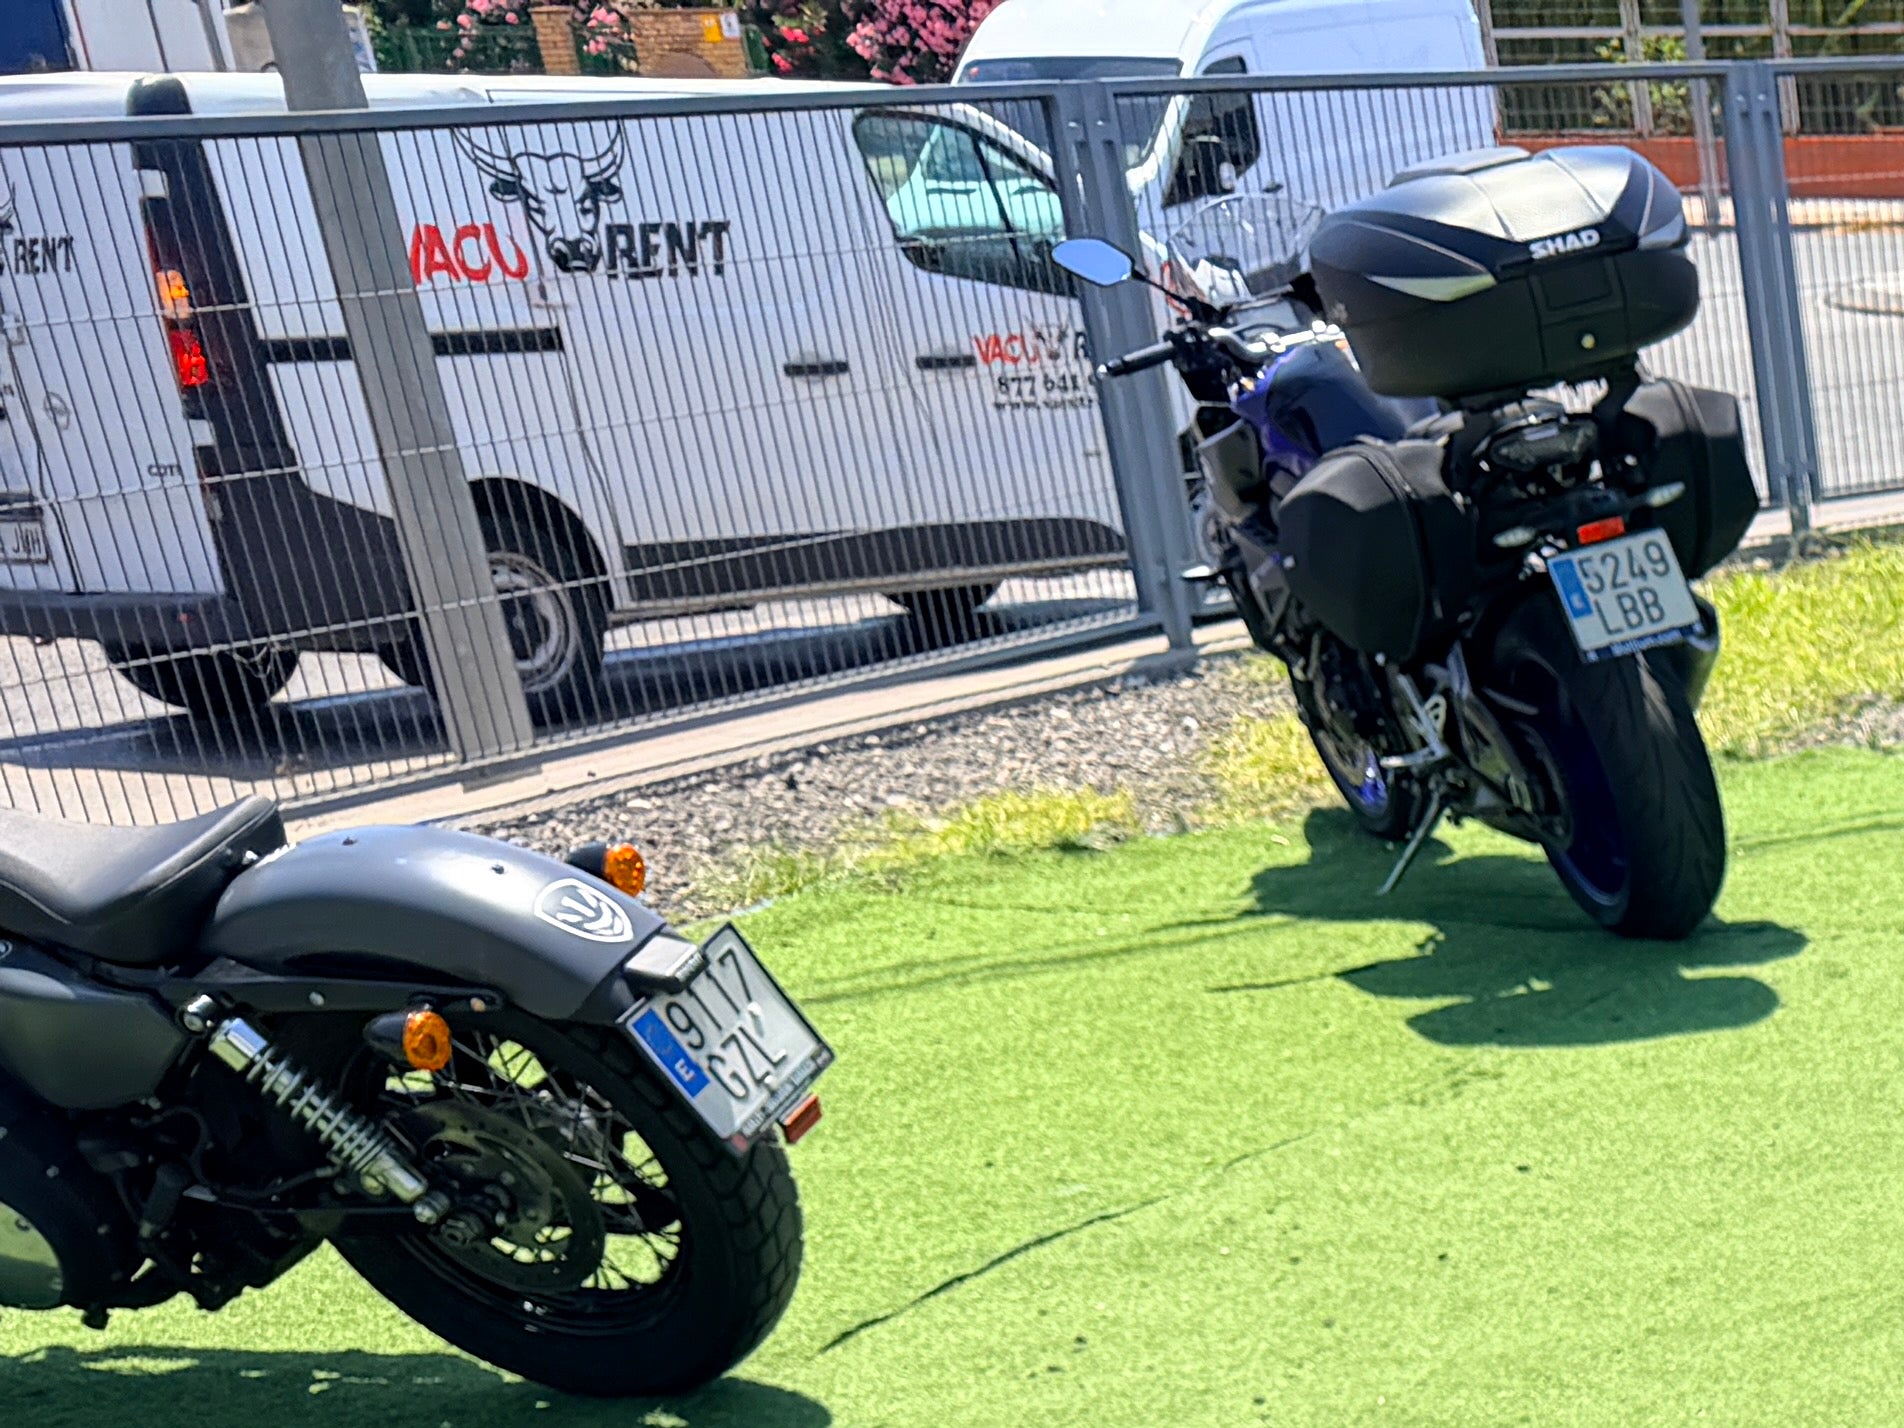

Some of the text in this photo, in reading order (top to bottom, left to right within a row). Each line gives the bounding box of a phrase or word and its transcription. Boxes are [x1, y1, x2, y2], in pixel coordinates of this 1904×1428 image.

[13, 236, 75, 274] RENT
[605, 219, 731, 279] RENT
[1529, 229, 1600, 260] SHAD
[1577, 540, 1671, 595] 5249
[1593, 587, 1666, 636] LBB
[665, 947, 754, 1051] 9117
[704, 1026, 787, 1100] GZL
